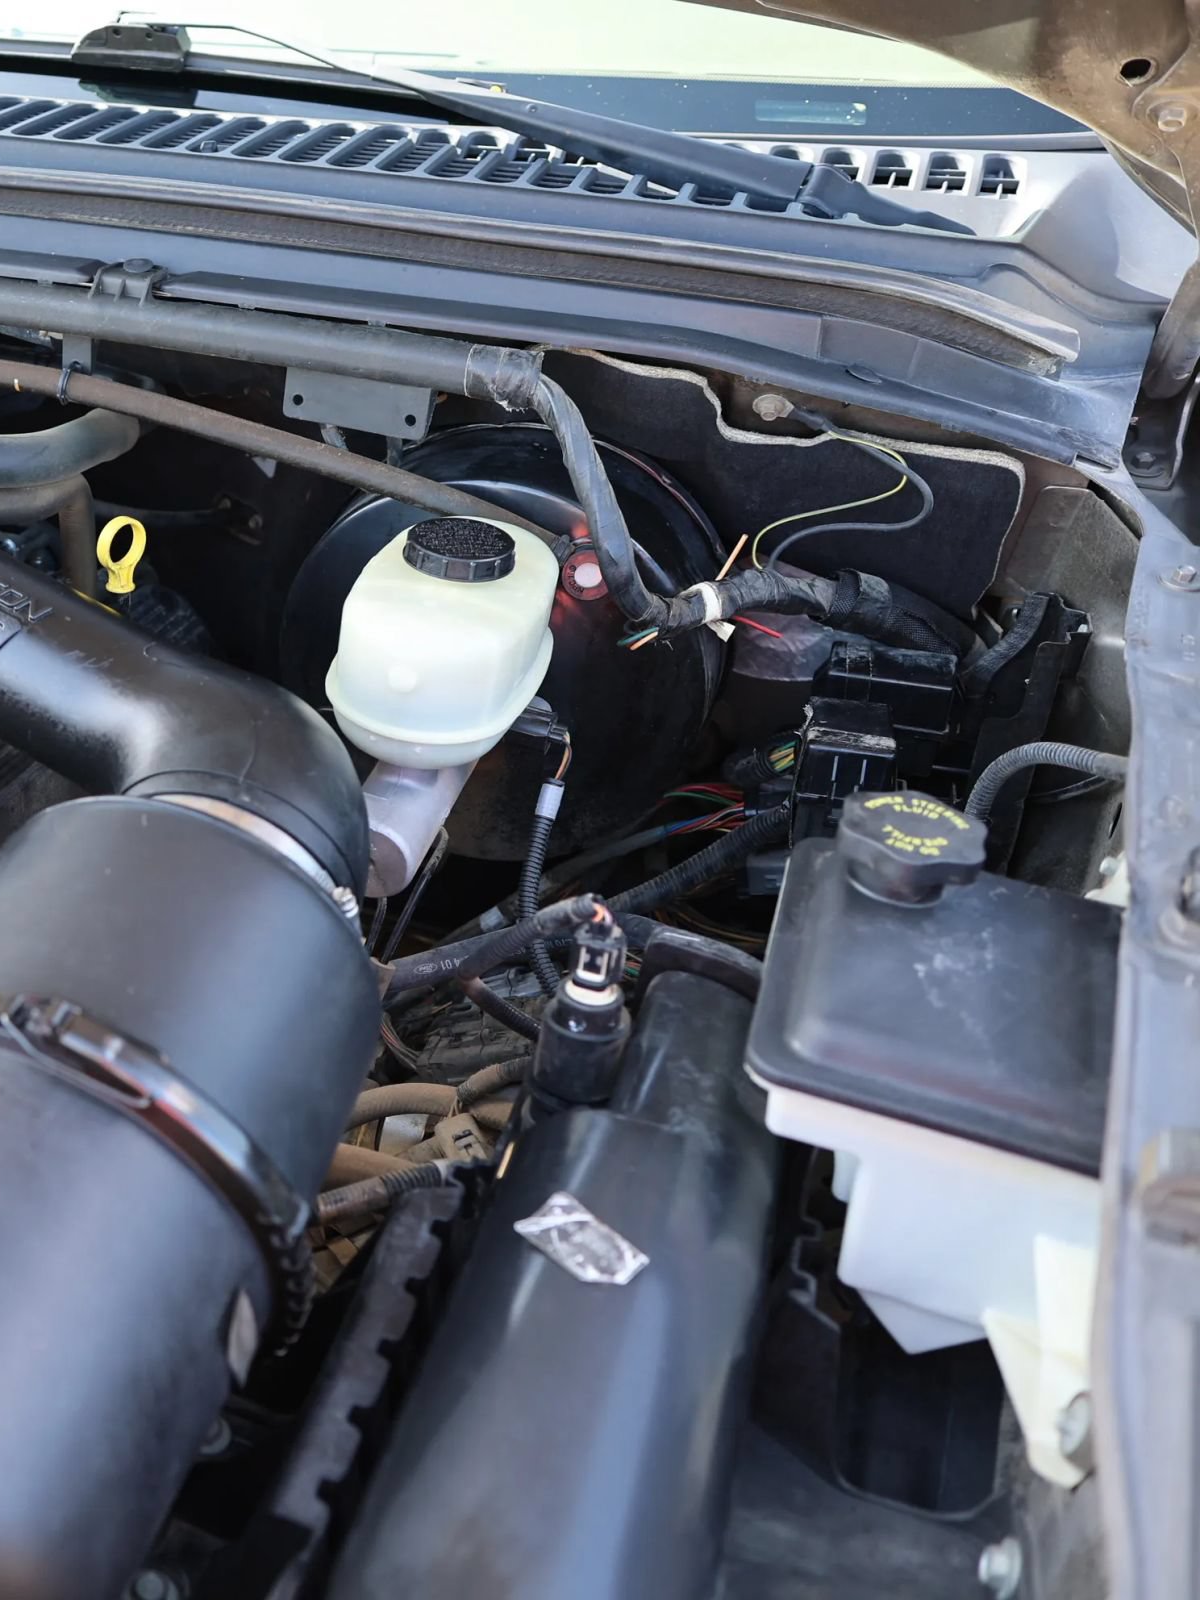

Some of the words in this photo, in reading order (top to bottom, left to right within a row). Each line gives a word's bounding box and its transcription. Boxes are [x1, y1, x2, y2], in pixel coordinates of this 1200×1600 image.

[864, 797, 904, 809] POWER
[912, 798, 970, 829] STEERING
[894, 803, 940, 819] FLUID
